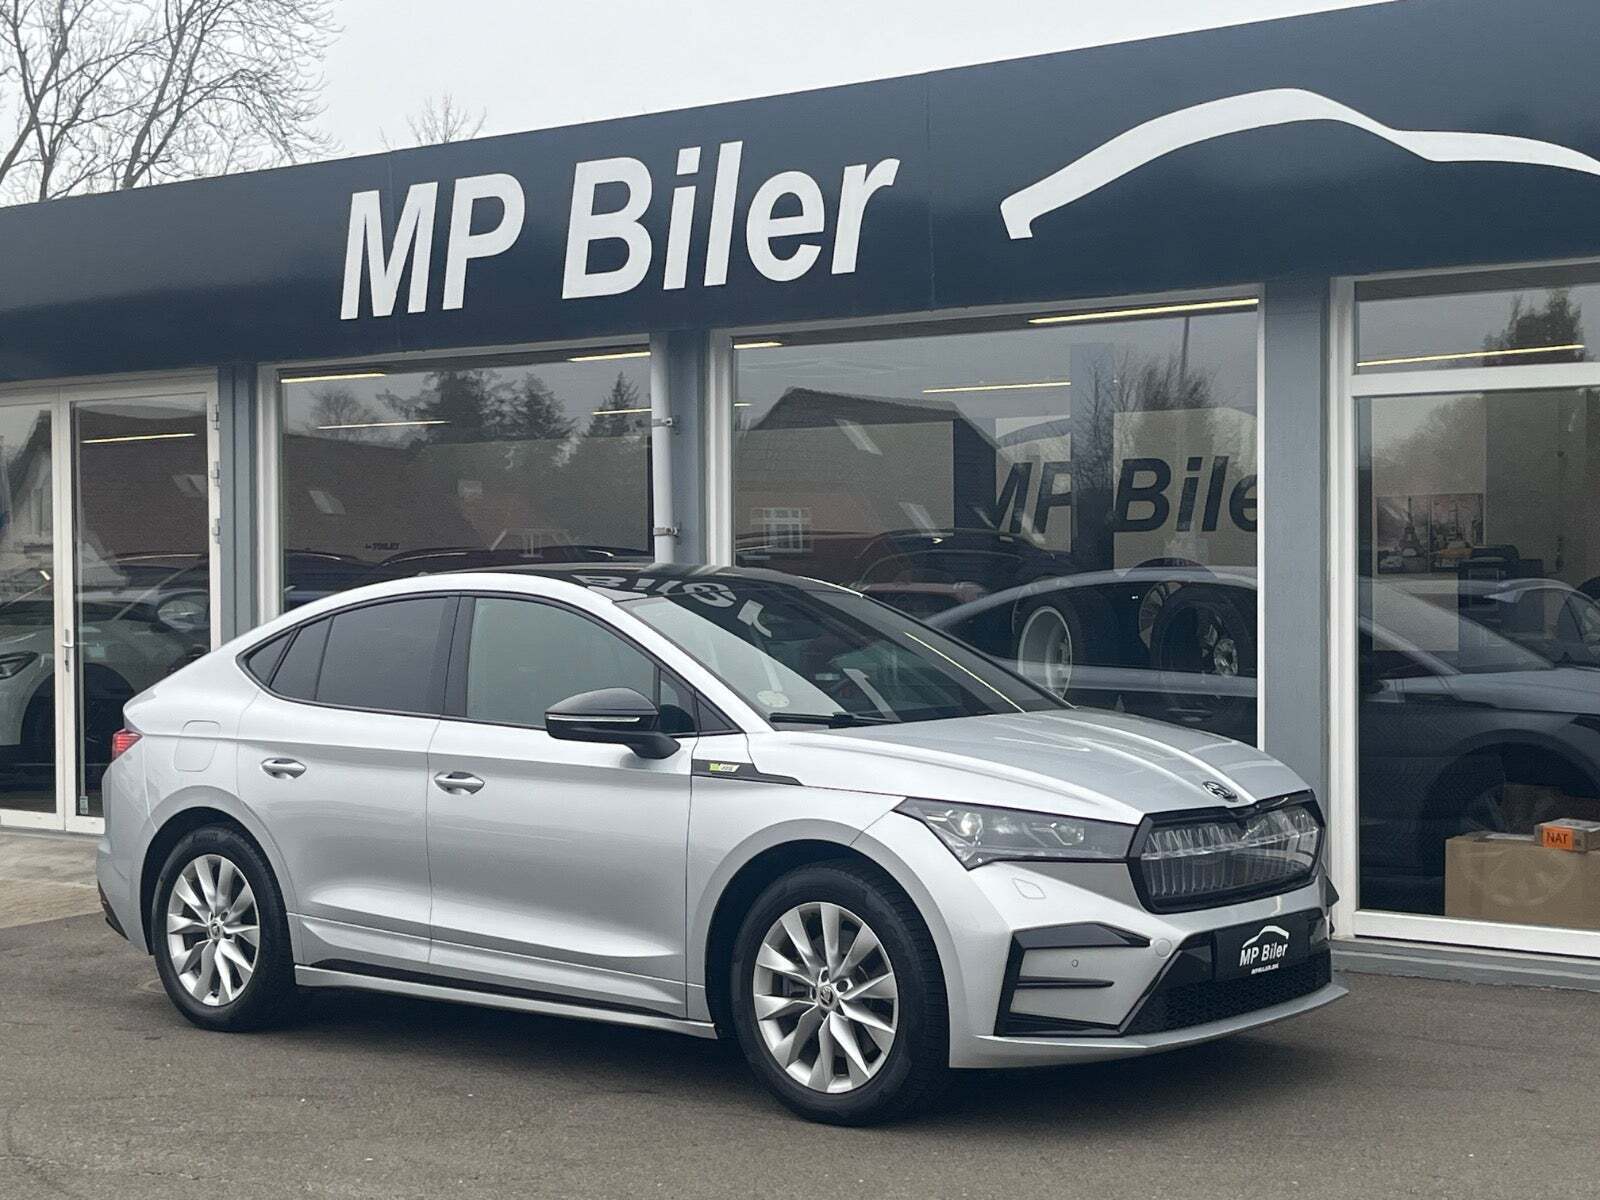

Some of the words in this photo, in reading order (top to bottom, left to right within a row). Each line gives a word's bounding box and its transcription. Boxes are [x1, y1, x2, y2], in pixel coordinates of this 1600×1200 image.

[340, 172, 525, 320] MP
[562, 141, 900, 300] Biler
[1113, 456, 1257, 532] Bile
[1546, 831, 1568, 845] NAT
[1239, 946, 1260, 967] MP
[1261, 942, 1288, 961] Biler
